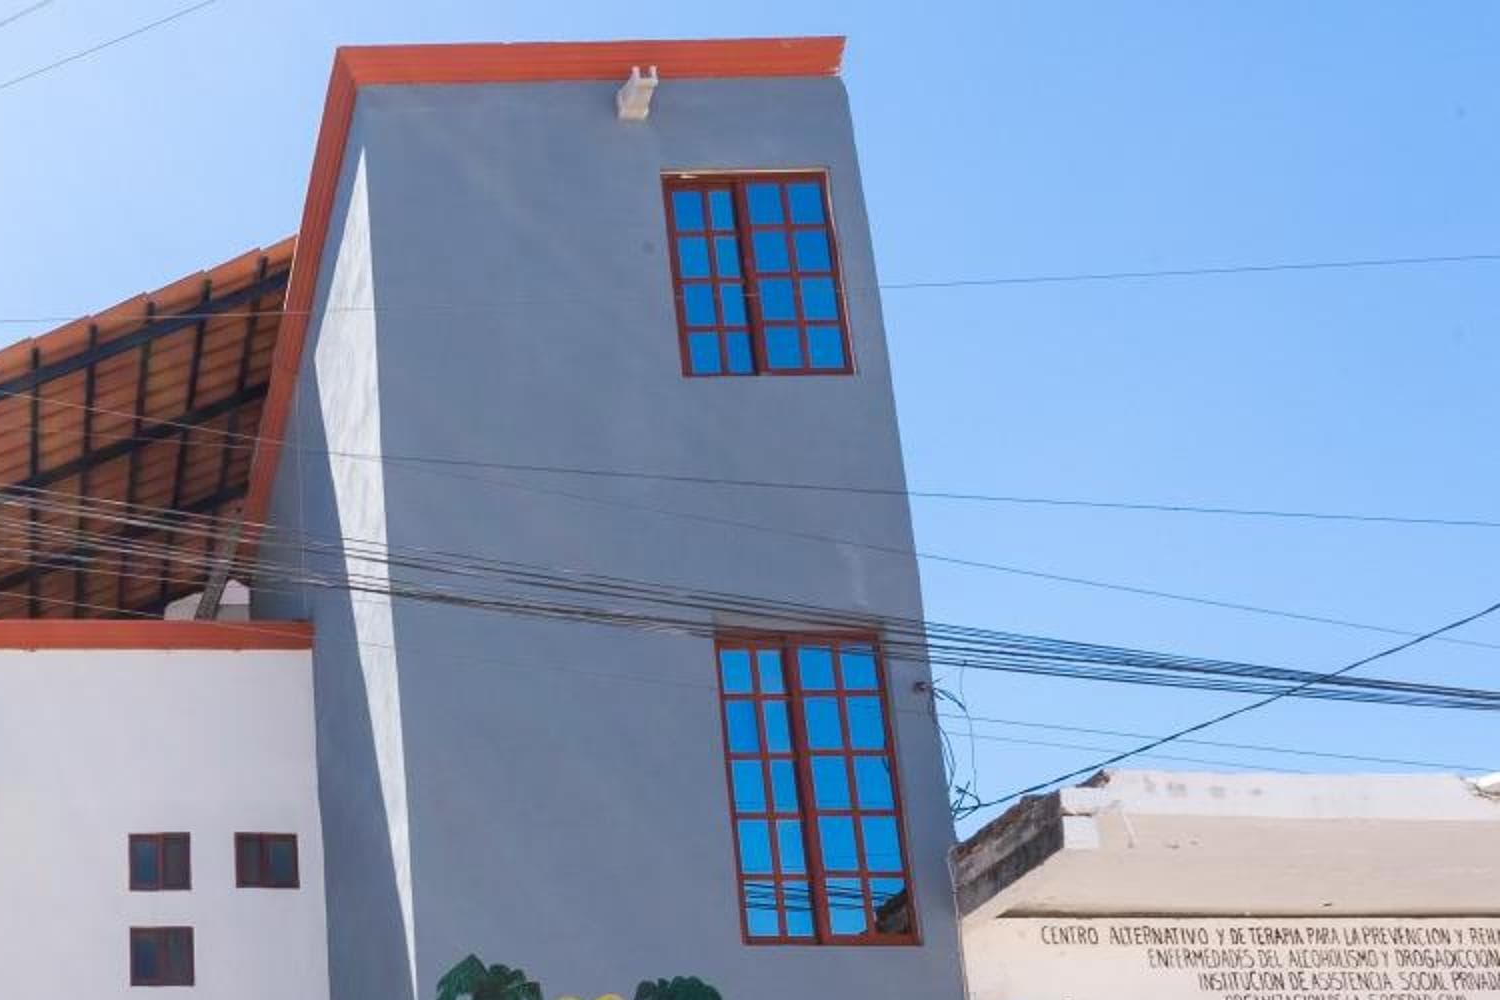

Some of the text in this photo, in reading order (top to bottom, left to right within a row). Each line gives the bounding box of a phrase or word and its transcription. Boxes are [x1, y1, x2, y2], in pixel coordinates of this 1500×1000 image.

[1041, 925, 1099, 945] CENTRO
[1109, 925, 1209, 945] ALTERNATIVO
[1215, 927, 1225, 946] Y
[1230, 927, 1246, 945] DE
[1248, 927, 1304, 945] TERAPIA
[1306, 927, 1340, 945] PARA
[1343, 927, 1360, 946] LA
[1361, 926, 1451, 945] PREVENCION
[1453, 927, 1463, 945] Y
[1147, 948, 1255, 968] ENFERMEDADES
[1257, 949, 1283, 968] DEL
[1288, 949, 1378, 968] ALCOHOLISMO
[1381, 949, 1389, 968] Y
[1198, 971, 1285, 991] INSTITUCION
[1288, 971, 1309, 990] DE
[1312, 971, 1393, 991] ASISTENCIA
[1398, 971, 1449, 991] SOCIAL
